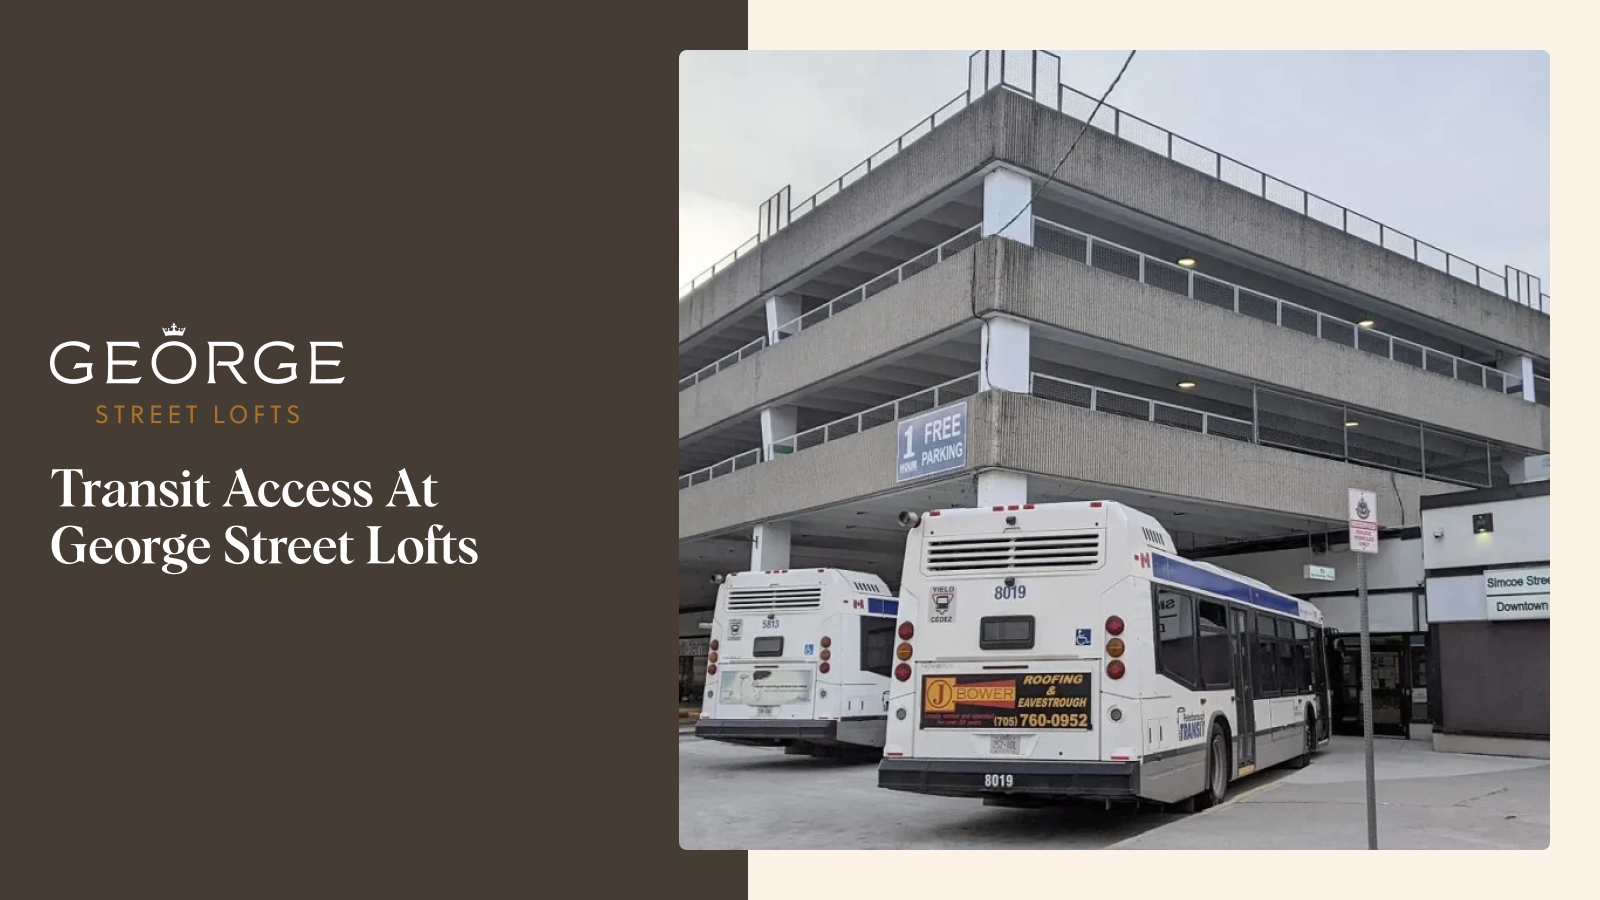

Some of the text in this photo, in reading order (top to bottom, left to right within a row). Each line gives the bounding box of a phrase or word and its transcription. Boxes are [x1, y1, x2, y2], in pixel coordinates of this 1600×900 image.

[925, 413, 961, 445] FREE
[903, 425, 916, 460] 1
[921, 442, 963, 467] PARKING
[899, 460, 918, 473] HOUR
[1487, 577, 1524, 588] Simcoe
[994, 585, 1026, 600] 8019
[1496, 601, 1549, 612] Downtown
[1023, 674, 1084, 685] ROOFING
[933, 684, 945, 704] J
[956, 687, 1014, 700] BOWER
[1046, 685, 1056, 696] &
[1017, 698, 1087, 708] EAVESTROUGH
[994, 713, 1088, 727] (705) 760-0952
[1178, 720, 1205, 741] TRANSIT
[984, 774, 1013, 787] 8019
